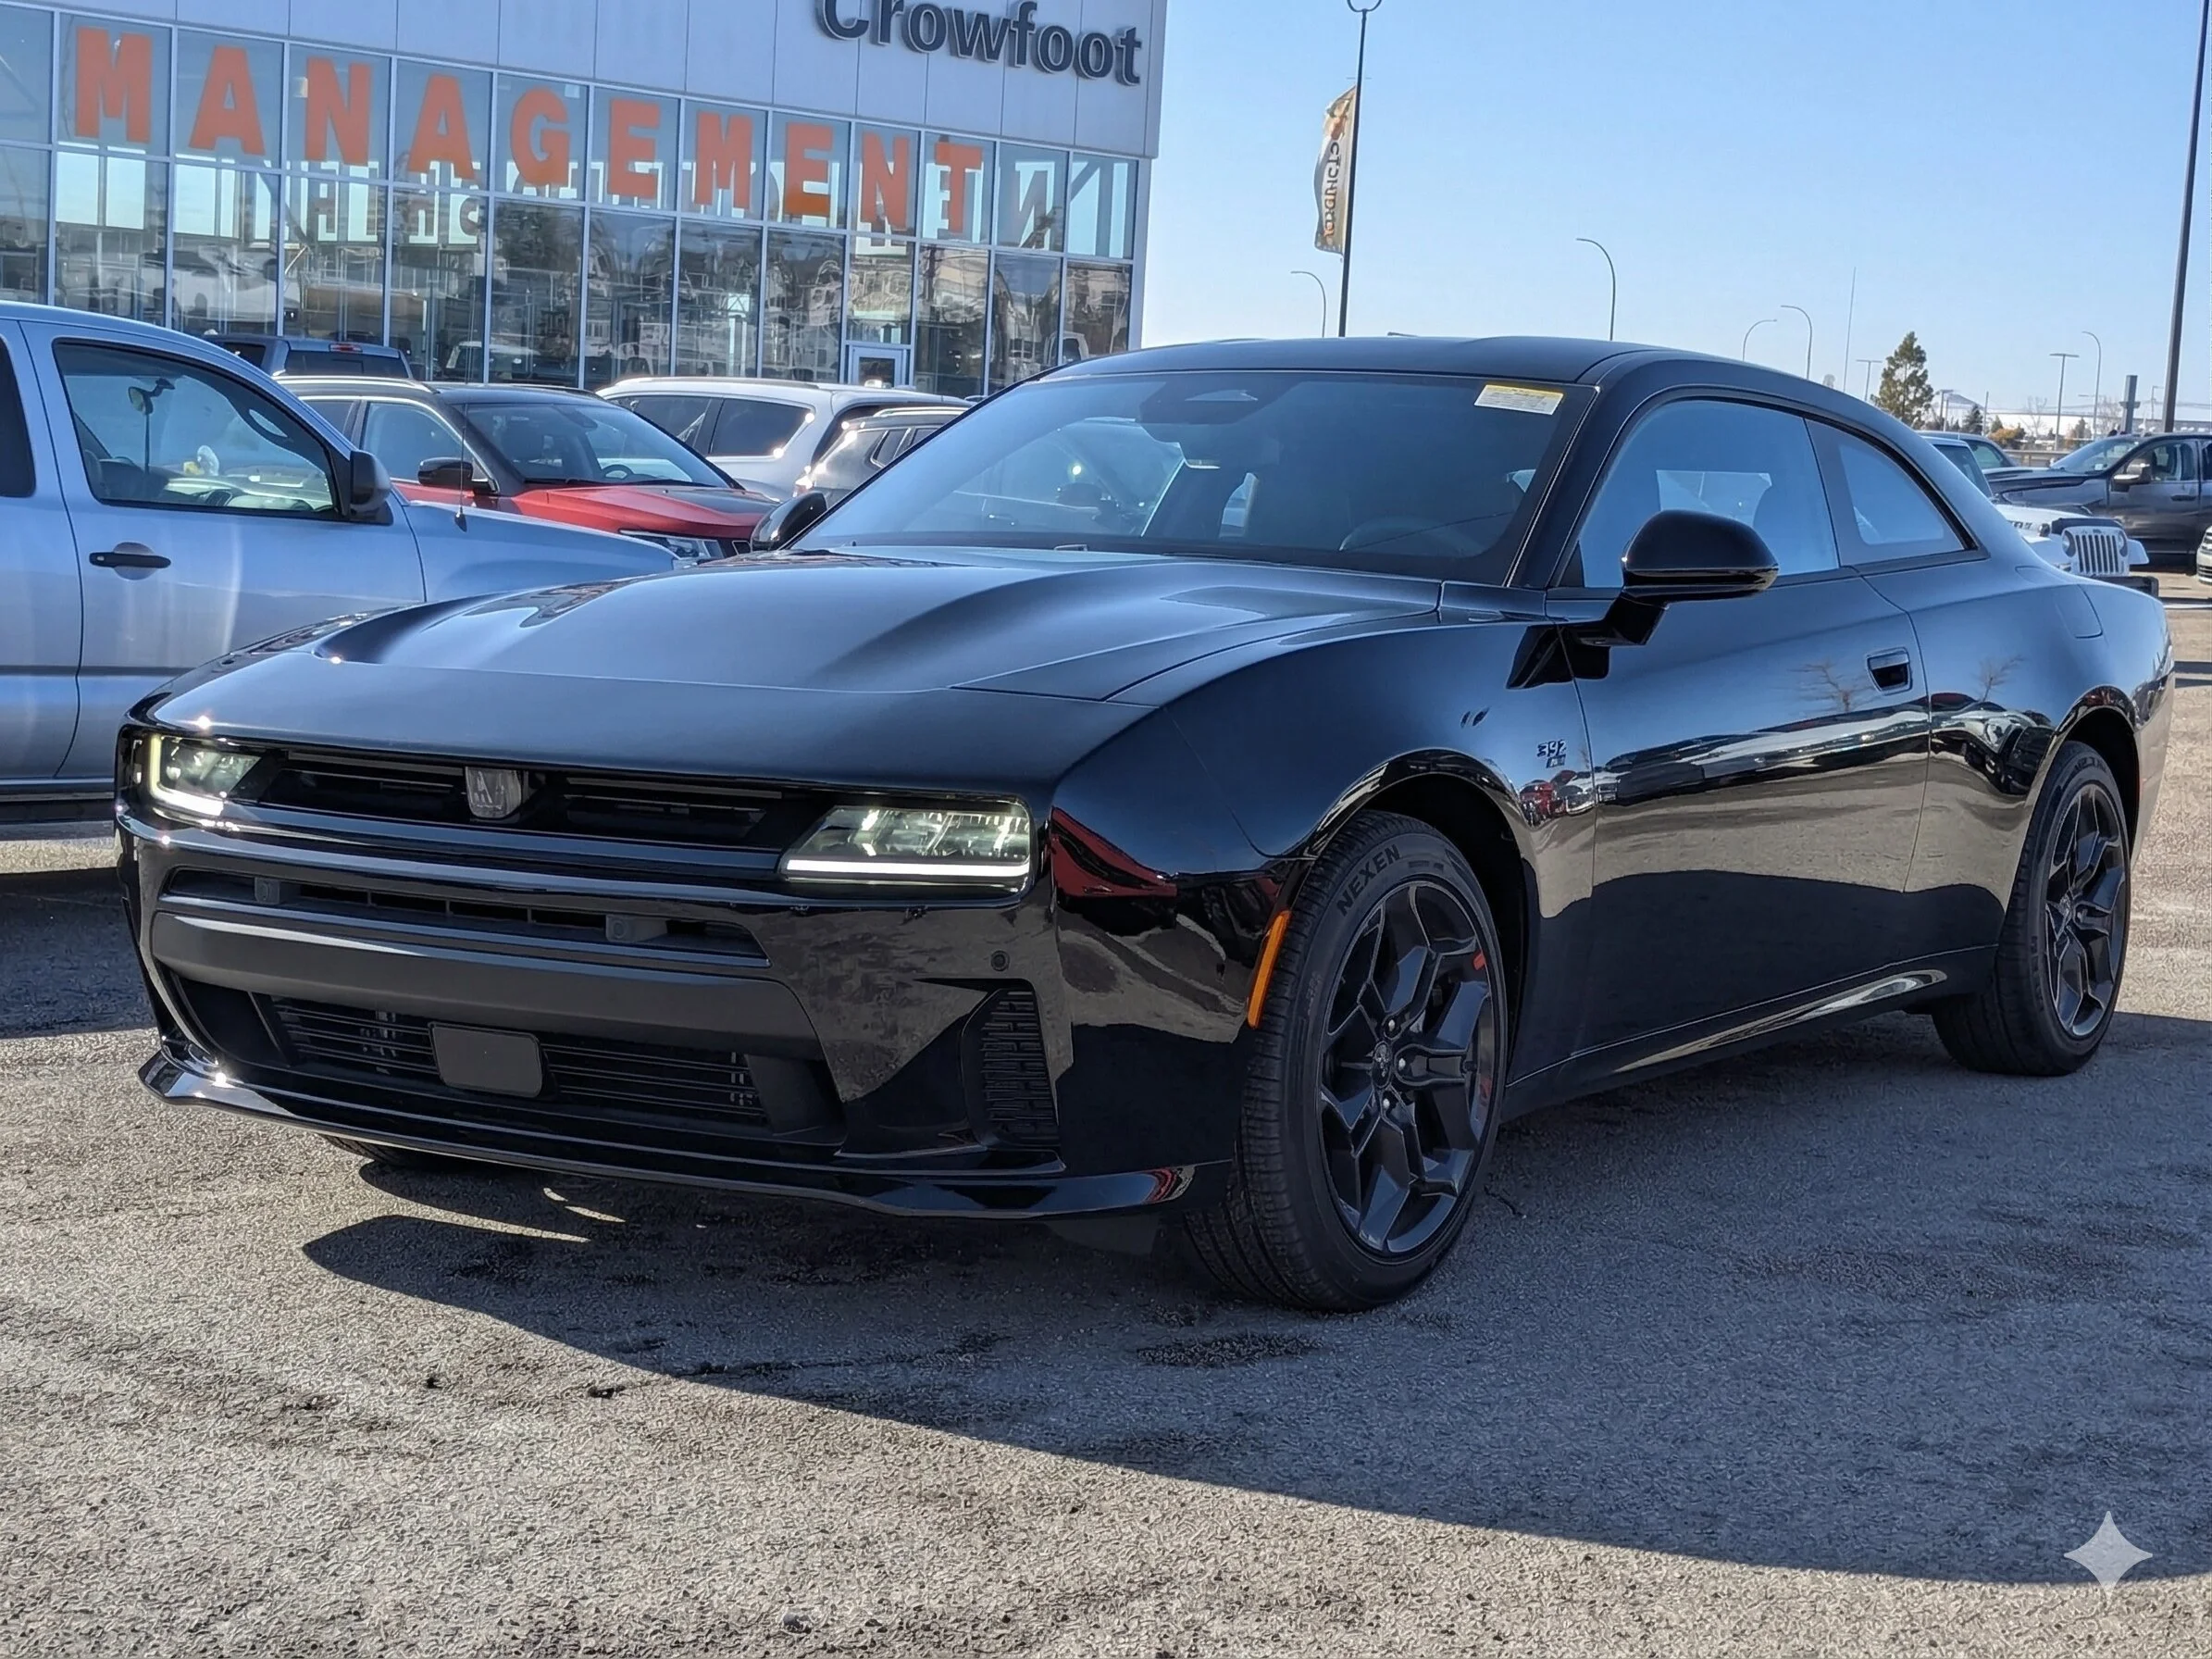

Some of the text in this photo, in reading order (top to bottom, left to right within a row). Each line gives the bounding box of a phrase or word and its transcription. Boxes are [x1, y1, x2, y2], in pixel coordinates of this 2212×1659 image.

[819, 0, 1142, 84] Crowfoot
[74, 26, 984, 233] MANAGEMENT
[1336, 843, 1401, 917] NEXEN
